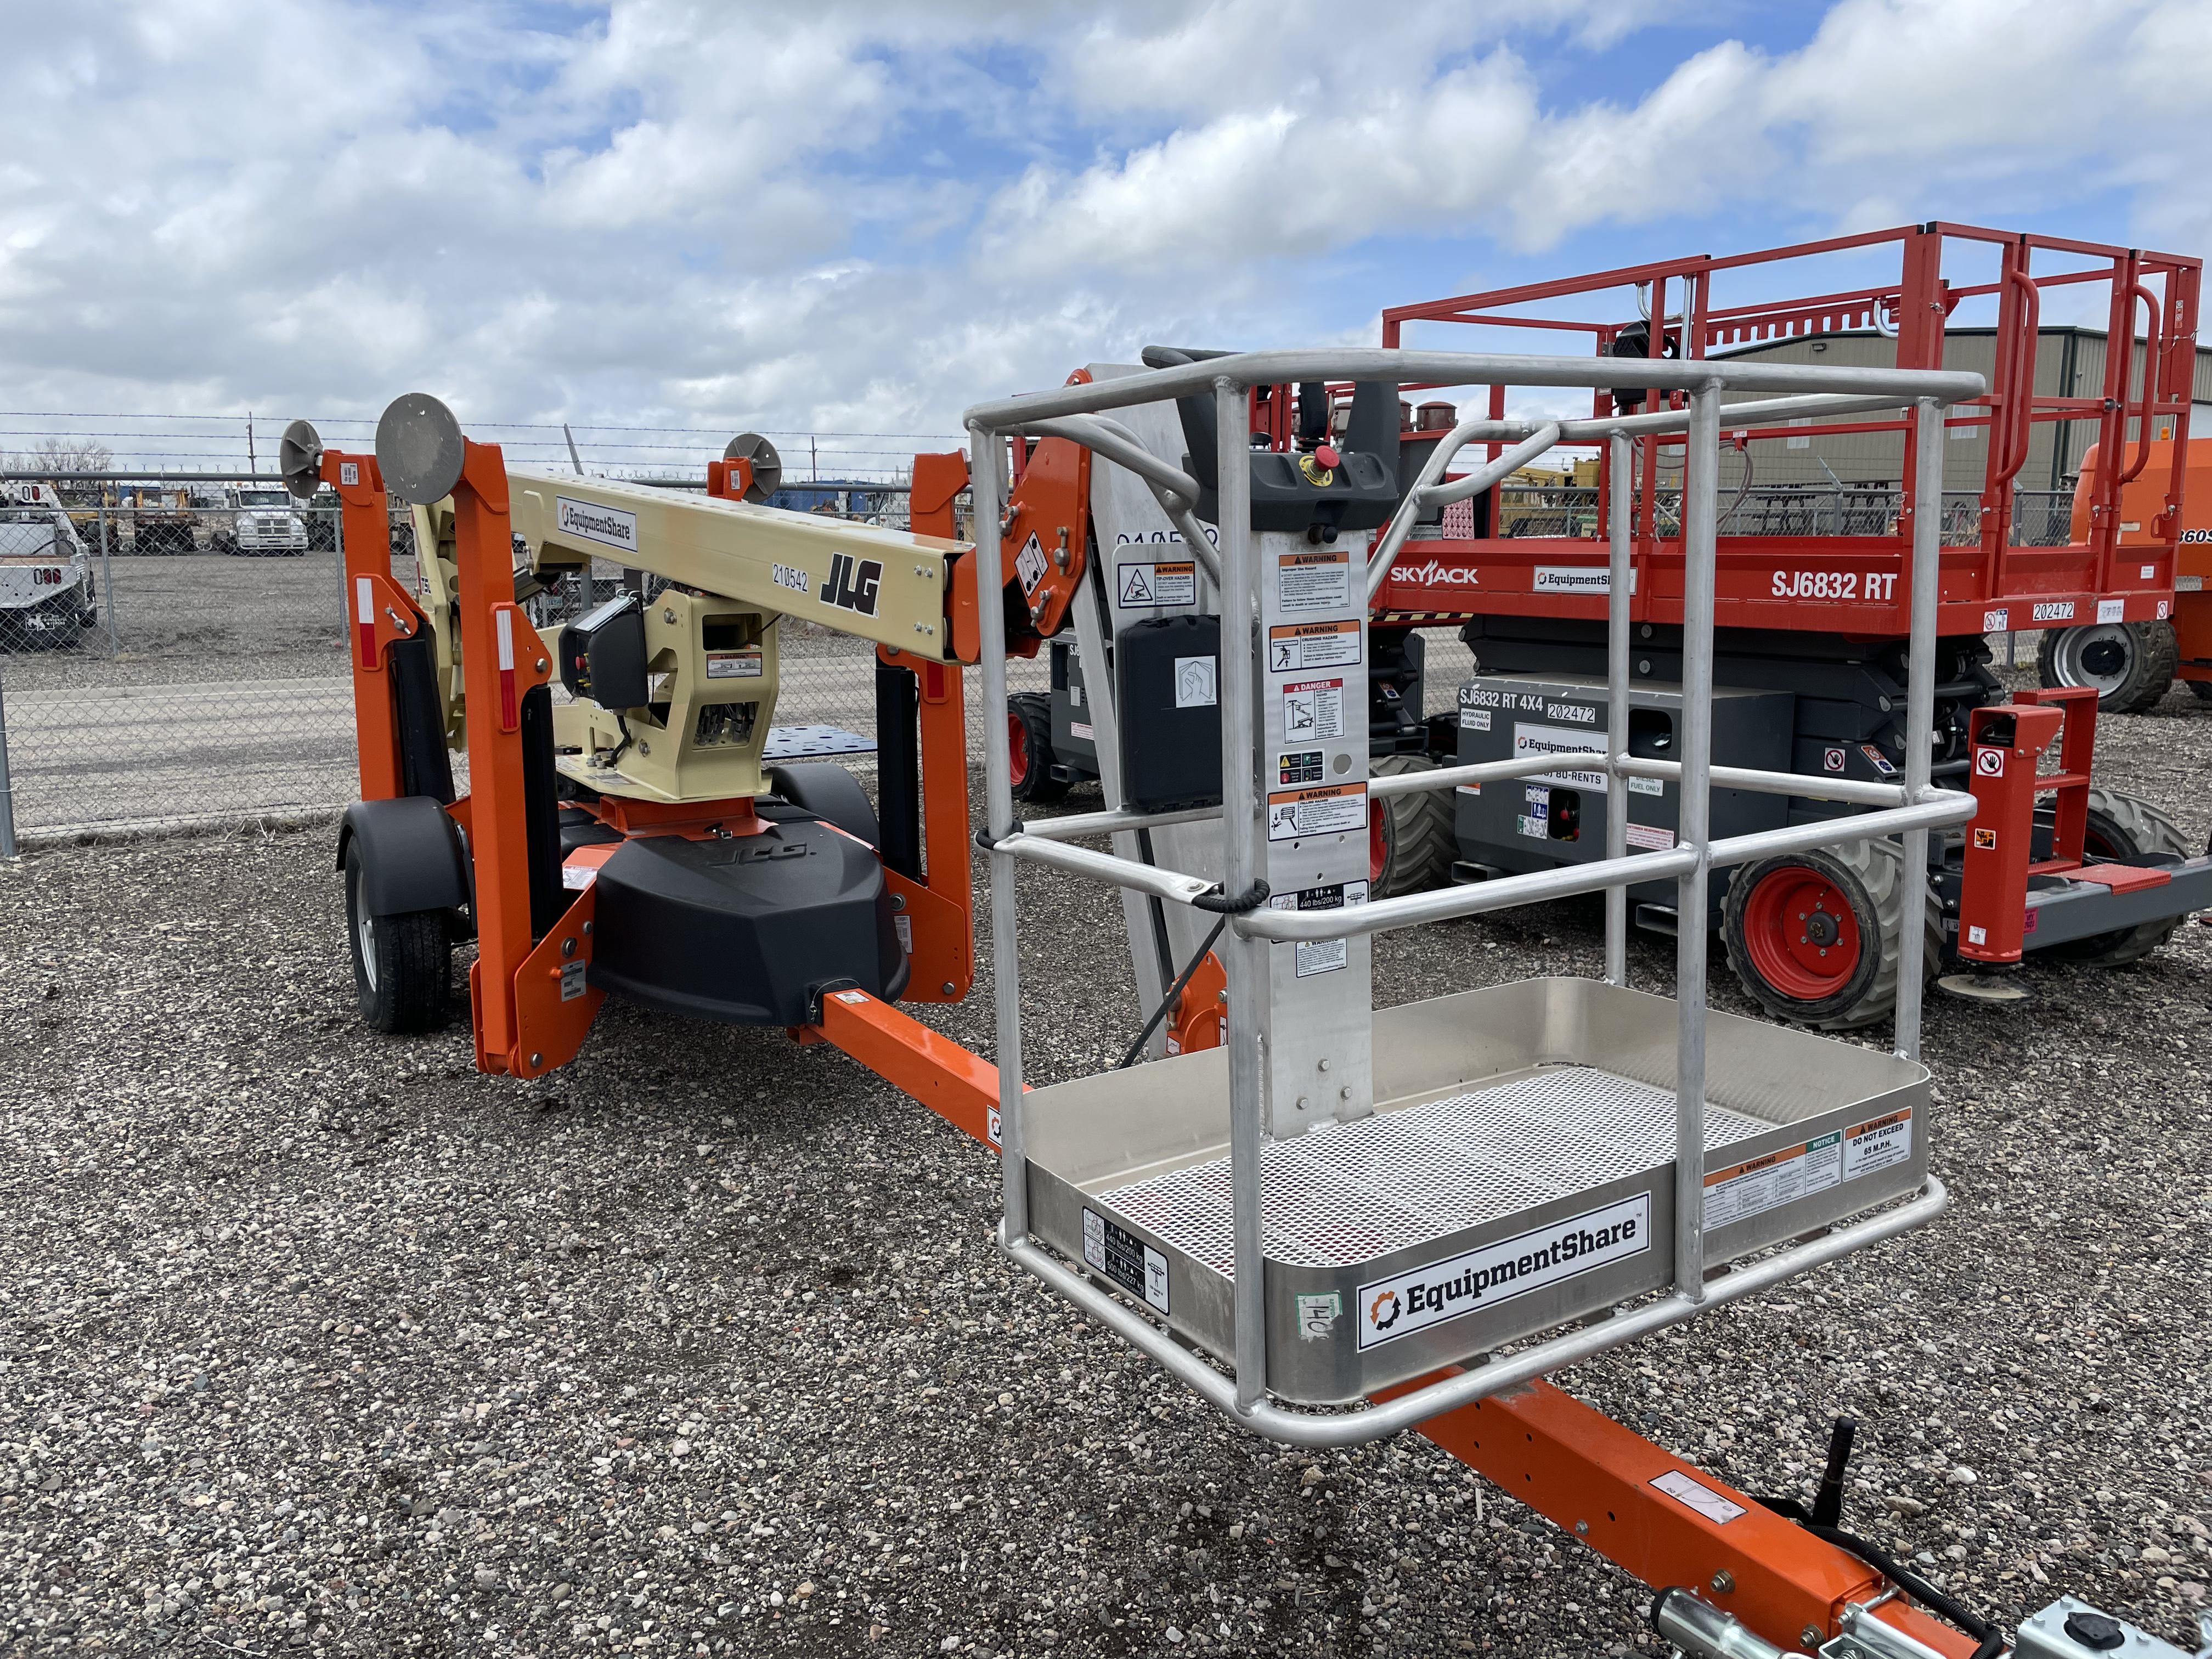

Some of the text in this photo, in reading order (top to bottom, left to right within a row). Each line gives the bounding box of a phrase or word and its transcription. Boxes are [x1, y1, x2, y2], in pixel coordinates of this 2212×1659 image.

[569, 507, 630, 540] EquipmentShare
[774, 564, 808, 592] 210542
[1391, 559, 1479, 586] SKYJACK
[820, 553, 883, 616] JLG
[1771, 570, 1898, 600] SJ6832 RT
[2034, 603, 2074, 619] 202472
[1302, 625, 1338, 634] WARNING
[1301, 681, 1331, 691] DANGER
[1460, 689, 1543, 711] SJ6832 RT 4X4
[1462, 710, 1489, 719] HYDRAULIC
[1549, 704, 1594, 721] 202472
[1306, 788, 1341, 799] WARNING
[1312, 896, 1334, 906] lbs/200
[1867, 1115, 1898, 1131] WARNING
[1813, 1136, 1835, 1149] NOTICE
[1853, 1123, 1904, 1147] DO NOT EXCEED
[1864, 1146, 1872, 1155] 65
[1873, 1139, 1892, 1152] M.P.H.
[1746, 1156, 1776, 1171] WARNING
[1106, 1234, 1143, 1264] 440 lbs/200 kg
[1407, 1219, 1636, 1315] EquipmentShare
[1107, 1262, 1117, 1273] 500
[1118, 1267, 1136, 1285] lbs/227
[1137, 1280, 1144, 1293] kg
